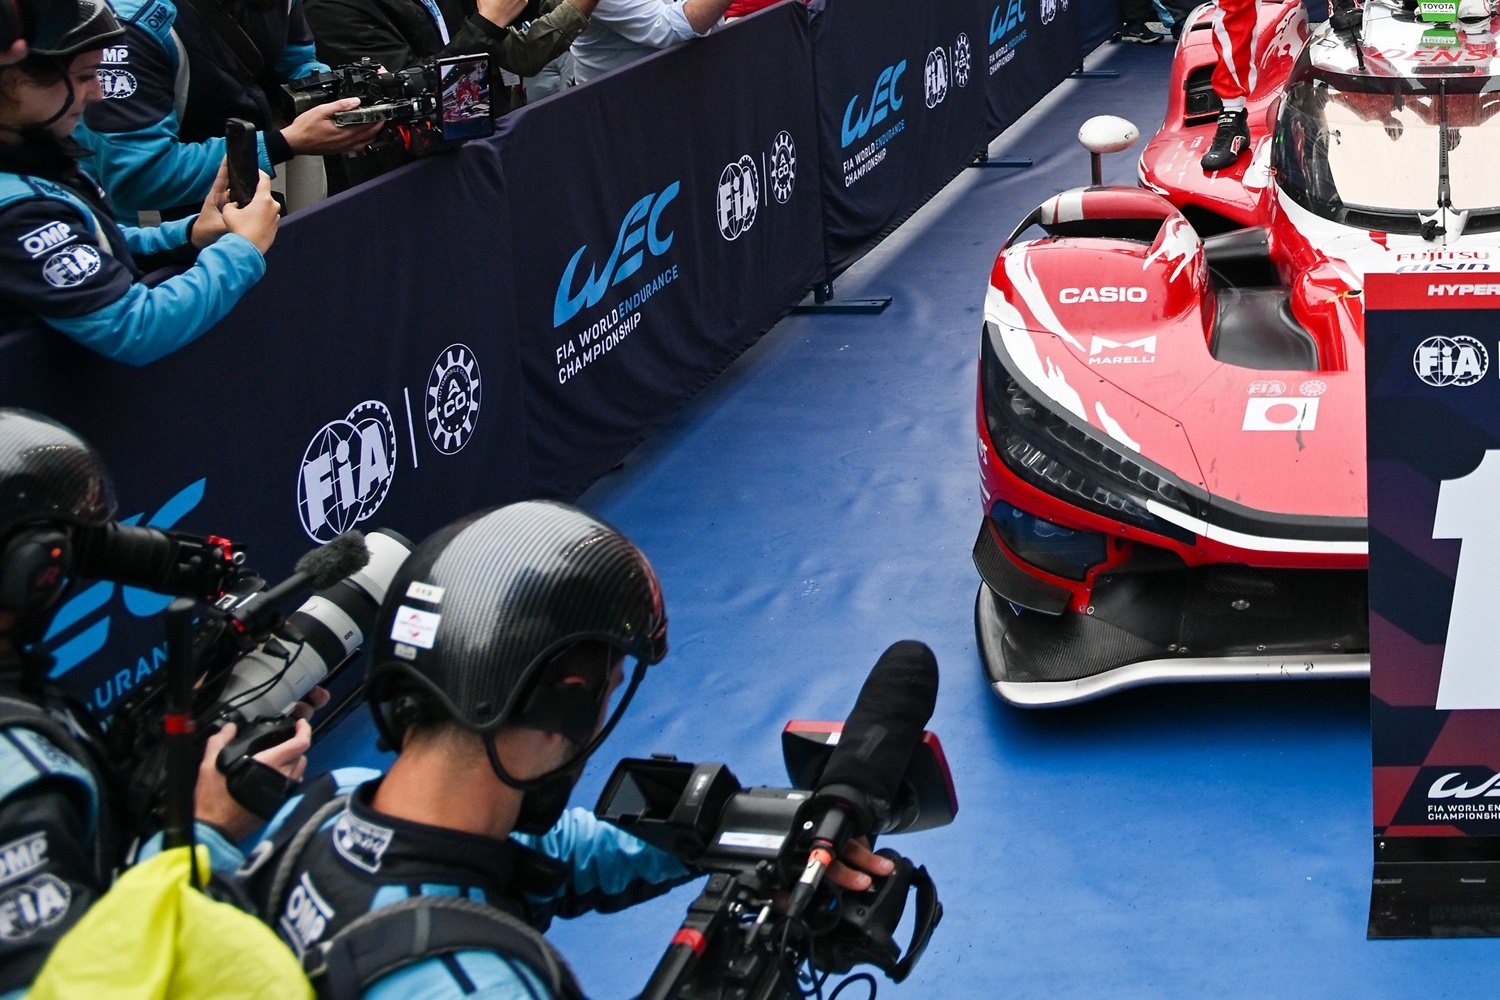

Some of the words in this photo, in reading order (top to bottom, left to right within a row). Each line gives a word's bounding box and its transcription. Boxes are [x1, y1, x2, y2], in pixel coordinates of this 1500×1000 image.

[148, 7, 169, 29] OMP
[1422, 3, 1455, 11] TOYOTA
[103, 48, 129, 62] MP
[988, 53, 996, 66] FIA
[995, 43, 1009, 62] WORLD
[1008, 29, 1027, 53] ENDURANCE
[988, 50, 1015, 76] CHAMPIONSHIP
[925, 55, 947, 102] FIA
[841, 59, 907, 149] WEC
[843, 156, 854, 174] FIA
[854, 139, 876, 167] WORLD
[875, 118, 905, 151] ENDURANCE
[777, 153, 789, 179] ACO
[844, 148, 887, 188] CHAMPIONSHIP
[718, 169, 756, 231] FIA
[23, 222, 71, 253] OMP
[553, 180, 680, 328] WEC
[45, 246, 96, 284] FIA
[1395, 263, 1491, 274] AISIN
[1396, 250, 1490, 263] FUJITSU
[1058, 286, 1148, 304] CASIO
[556, 339, 576, 365] FIA
[578, 308, 619, 348] WORLD
[618, 264, 679, 318] ENDURANCE
[558, 311, 642, 385] CHAMPIONSHIP
[1088, 354, 1156, 365] MARELLI
[1420, 346, 1482, 376] FIA
[443, 378, 467, 419] ACO
[1248, 381, 1284, 395] FIA
[303, 422, 390, 533] FIA
[1427, 804, 1445, 813] FIA
[1447, 804, 1486, 812] WORLD
[1, 882, 67, 937] FIA
[286, 884, 328, 948] OMP
